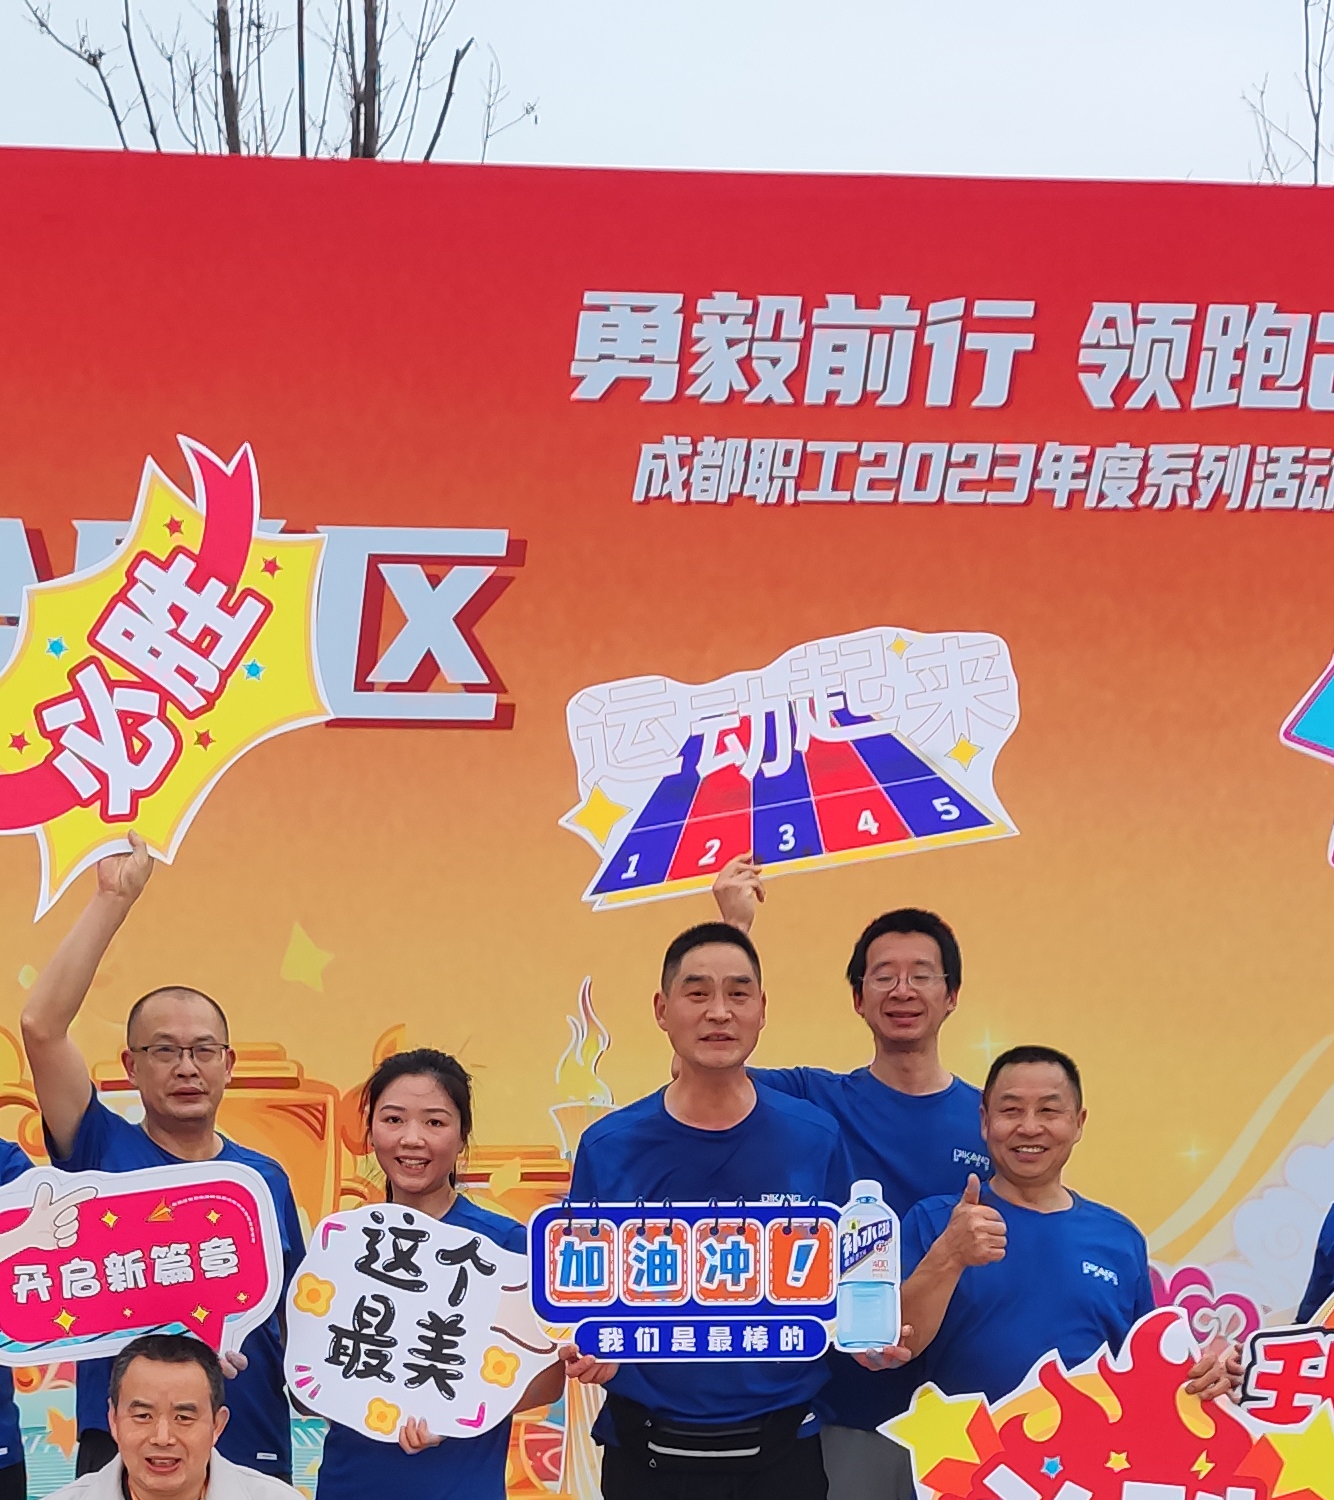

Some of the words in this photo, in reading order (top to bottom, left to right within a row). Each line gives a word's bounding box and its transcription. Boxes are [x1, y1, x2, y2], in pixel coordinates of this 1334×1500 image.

[571, 289, 1036, 408] 勇毅前行
[51, 552, 267, 816] 必胜
[574, 632, 1016, 788] 运动起来
[621, 853, 641, 882] 1
[697, 836, 721, 866] 2
[777, 823, 797, 851] 3
[857, 809, 880, 837] 4
[934, 795, 960, 822] 5
[12, 1235, 241, 1304] 开启新篇章
[354, 1210, 496, 1306] 这个
[559, 1237, 817, 1288] 加油冲!
[326, 1294, 467, 1400] 最美
[597, 1325, 806, 1353] 我们是最棒的
